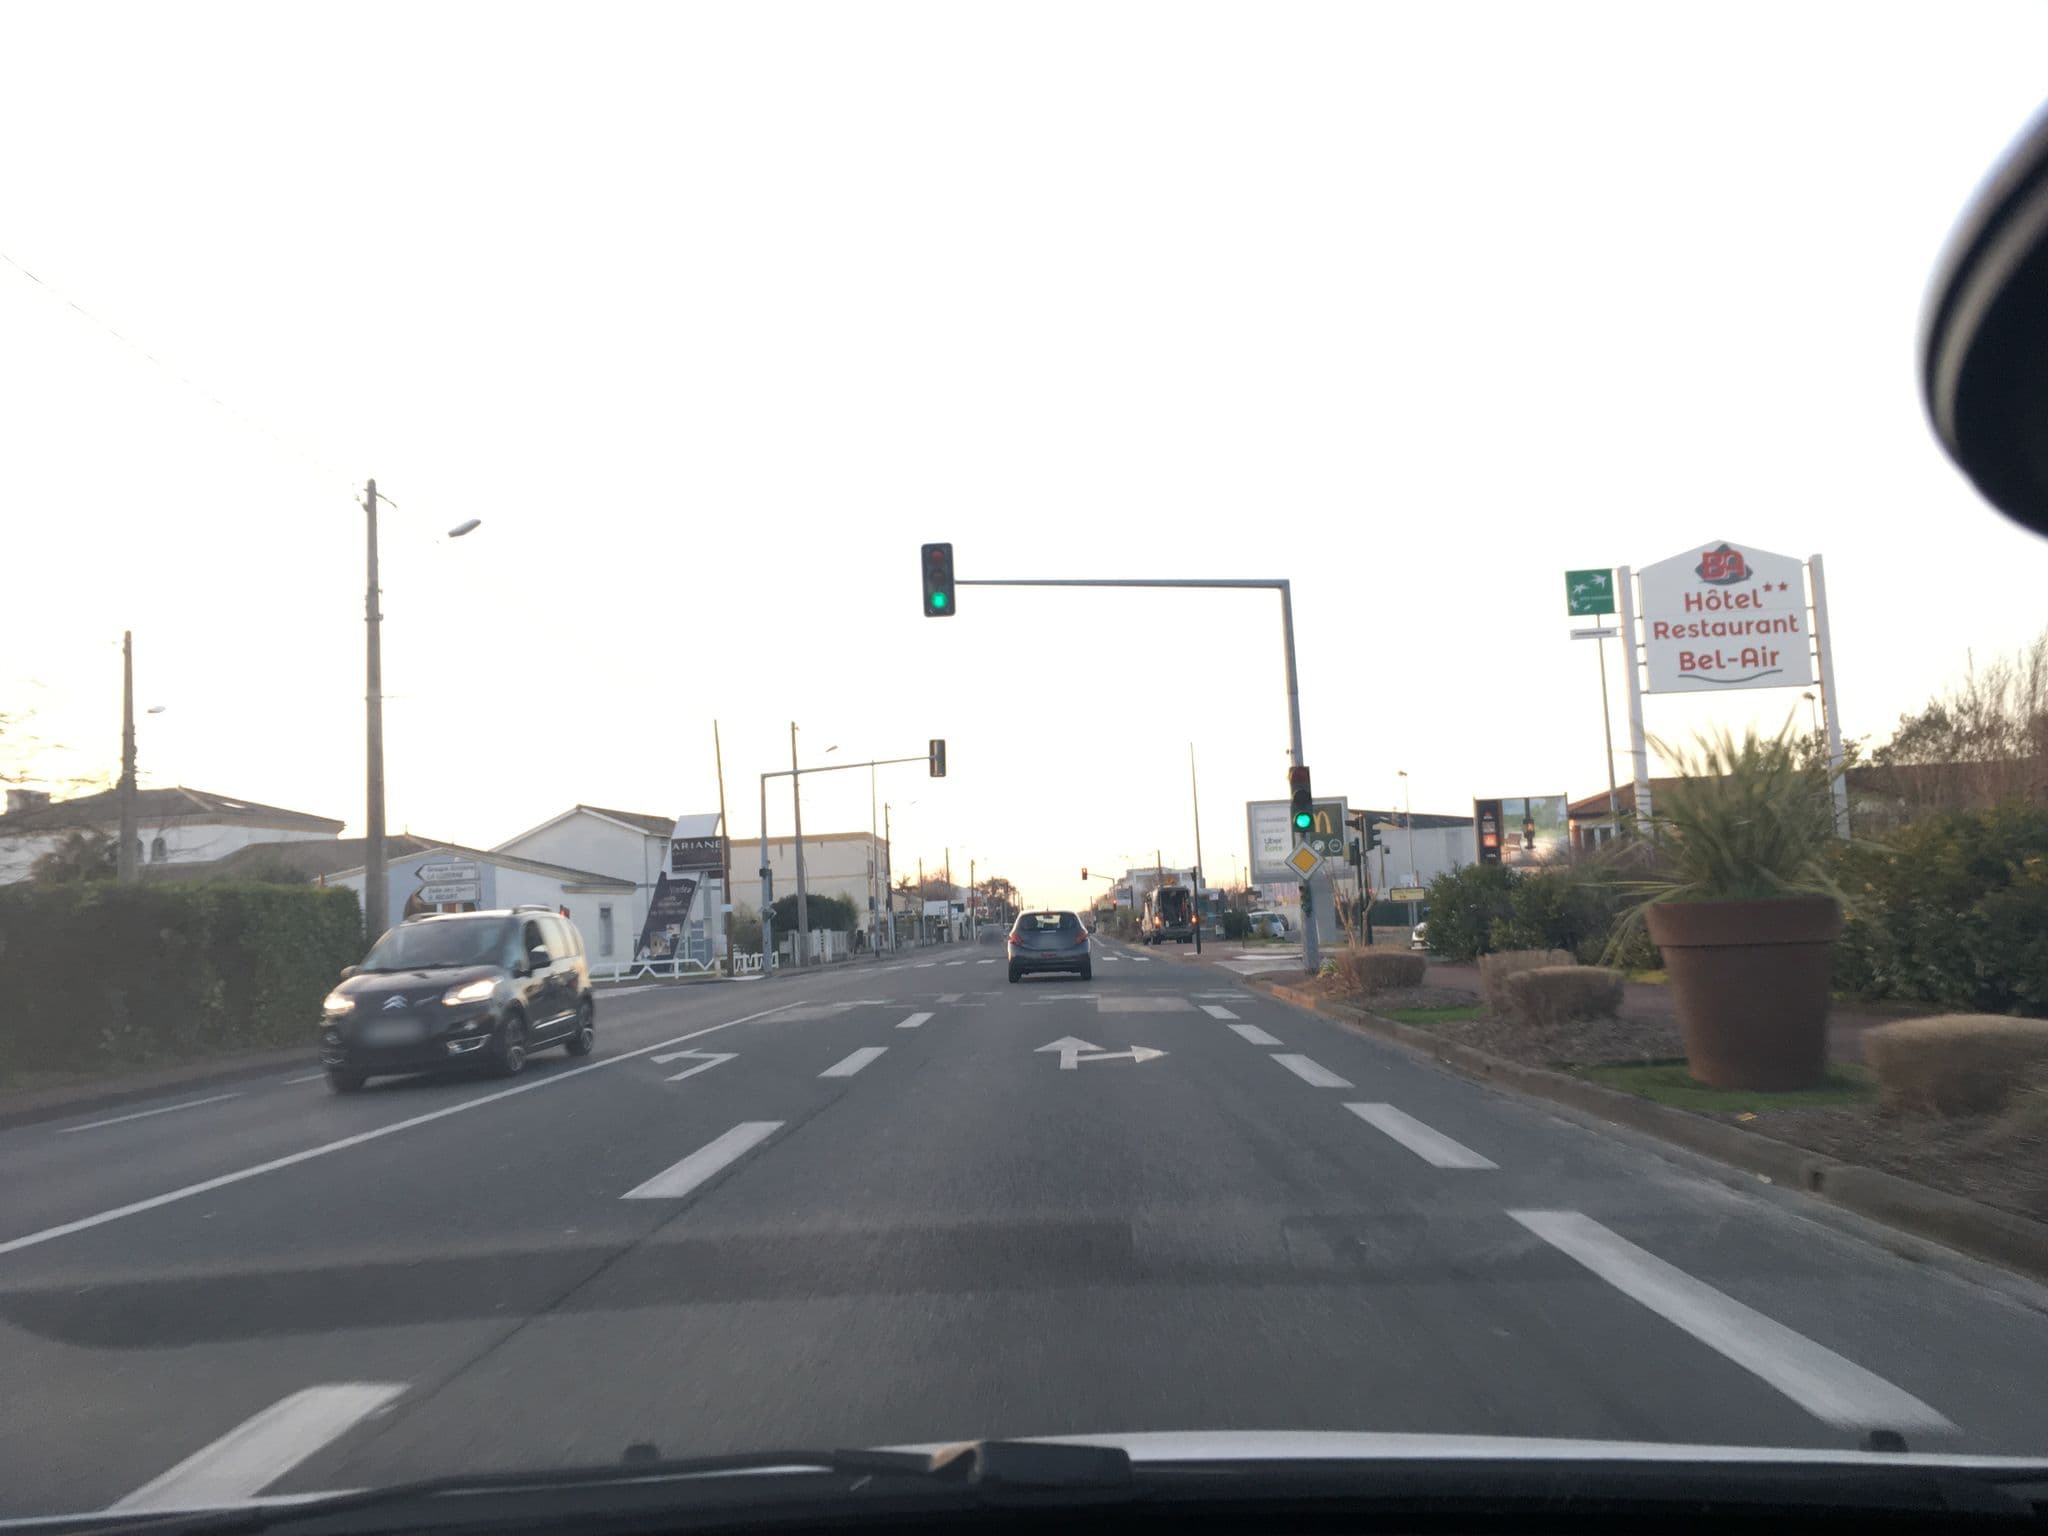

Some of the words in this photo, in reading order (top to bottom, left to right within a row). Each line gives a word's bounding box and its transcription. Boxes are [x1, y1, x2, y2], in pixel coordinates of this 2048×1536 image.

[1684, 588, 1763, 612] Hôtel
[1653, 614, 1800, 640] Restaurant
[1679, 646, 1780, 671] Bel-Air
[672, 840, 721, 850] ARIANE
